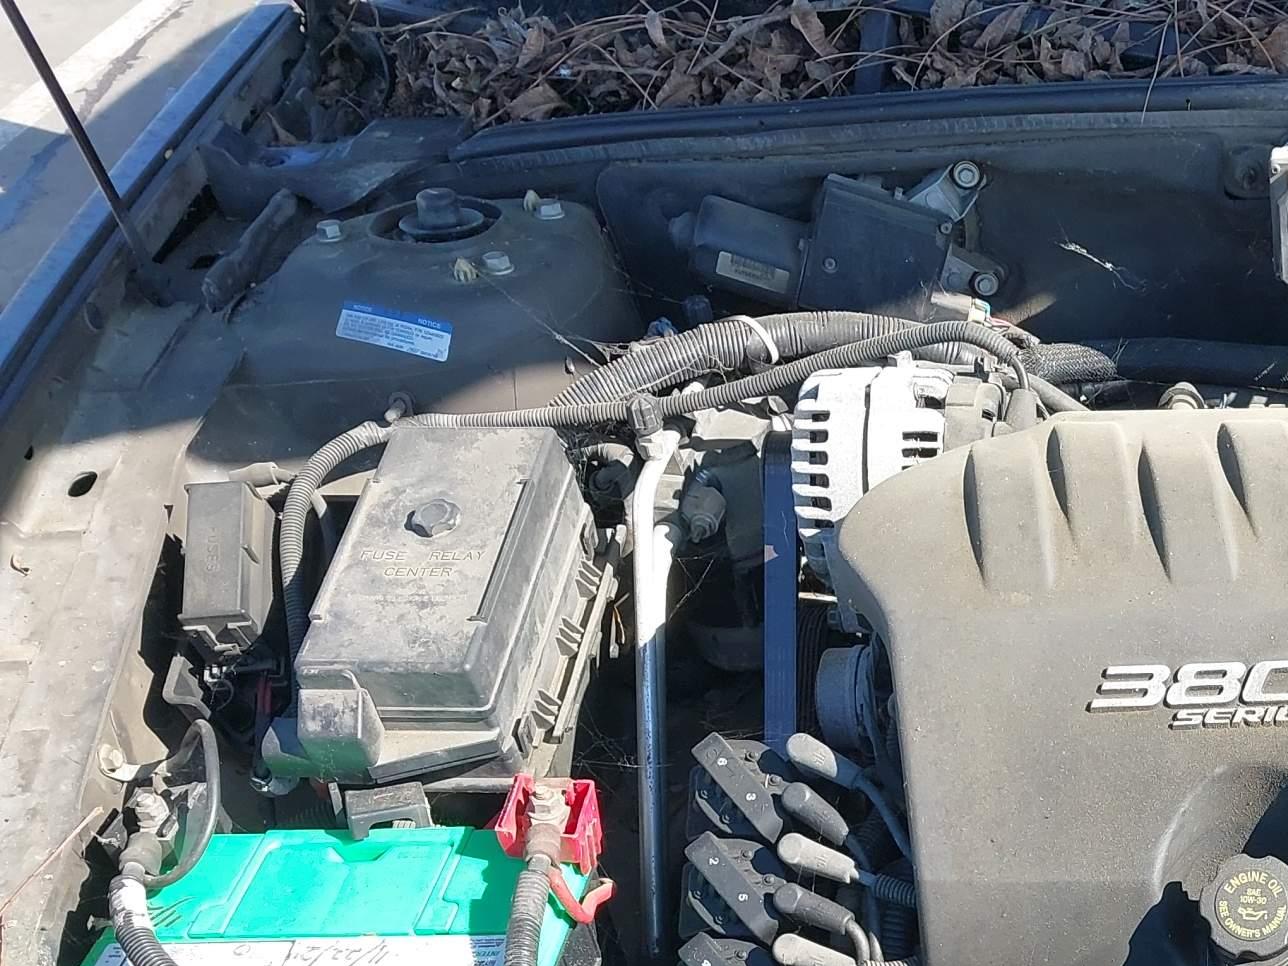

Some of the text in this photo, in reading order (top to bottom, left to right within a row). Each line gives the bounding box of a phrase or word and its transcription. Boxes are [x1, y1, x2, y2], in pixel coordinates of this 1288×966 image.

[417, 317, 442, 330] NOTICE
[360, 550, 486, 561] FUSE RELAY
[383, 567, 454, 577] CENTER
[717, 757, 728, 766] 6
[745, 792, 756, 801] 3
[709, 857, 720, 866] 2
[1223, 871, 1284, 898] ENGINE OIL
[1246, 888, 1262, 896] SAE
[738, 893, 748, 902] 5
[1240, 895, 1267, 905] 10W-30
[1218, 900, 1287, 938] SEE OWNER'S MANUAL
